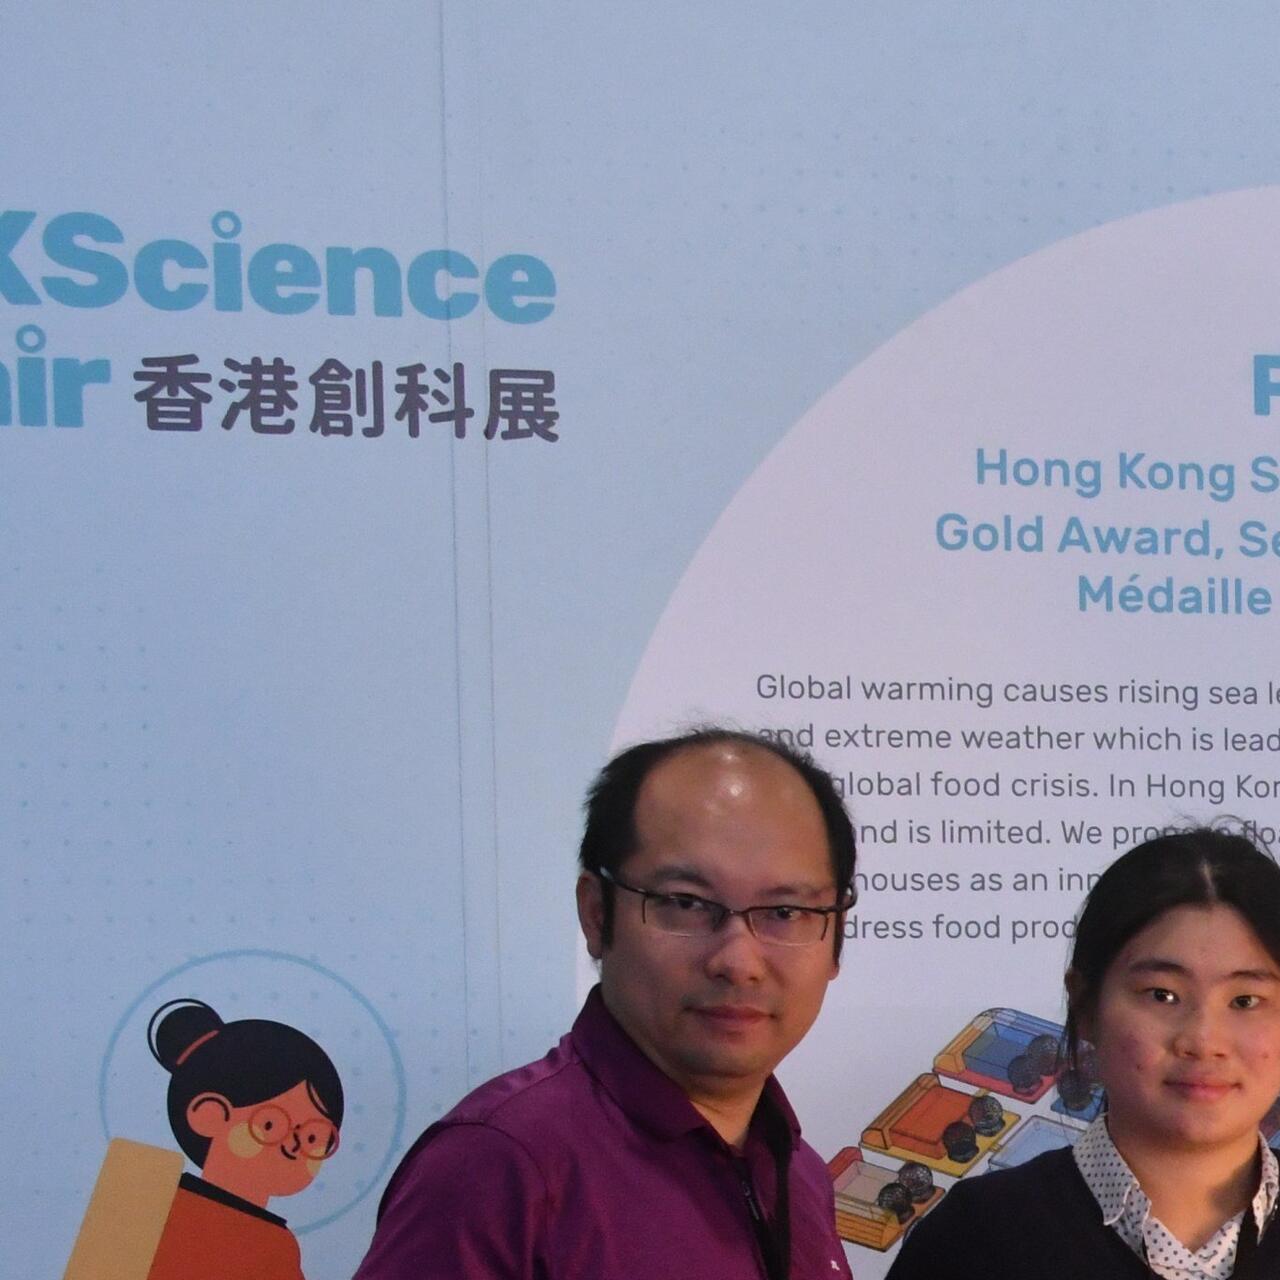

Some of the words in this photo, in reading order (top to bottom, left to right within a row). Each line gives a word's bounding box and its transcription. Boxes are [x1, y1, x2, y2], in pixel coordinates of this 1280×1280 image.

[0, 324, 111, 428] ir
[133, 354, 560, 443] 香港創科展
[977, 448, 1101, 499] Hong
[1119, 452, 1234, 502] Kong
[936, 513, 1043, 552] Gold
[1058, 517, 1223, 560] Award,
[1079, 574, 1272, 615] Médaille
[757, 675, 850, 699] Global
[862, 677, 992, 708] warming
[1004, 684, 1108, 703] causes
[1120, 679, 1198, 711] rising
[1210, 687, 1257, 704] sea
[759, 723, 813, 747] and
[825, 724, 951, 748] extreme
[961, 725, 1085, 749] weather
[1093, 727, 1181, 750] which
[1193, 727, 1213, 751] is
[931, 771, 999, 796] food
[1012, 779, 1098, 797] crisis.
[1110, 774, 1134, 797] In
[1148, 774, 1224, 804] Hong
[909, 820, 930, 843] is
[942, 820, 1050, 844] limited.
[1061, 821, 1102, 844] We
[971, 873, 1002, 891] as
[1013, 873, 1047, 891] an
[932, 914, 1000, 938] food
